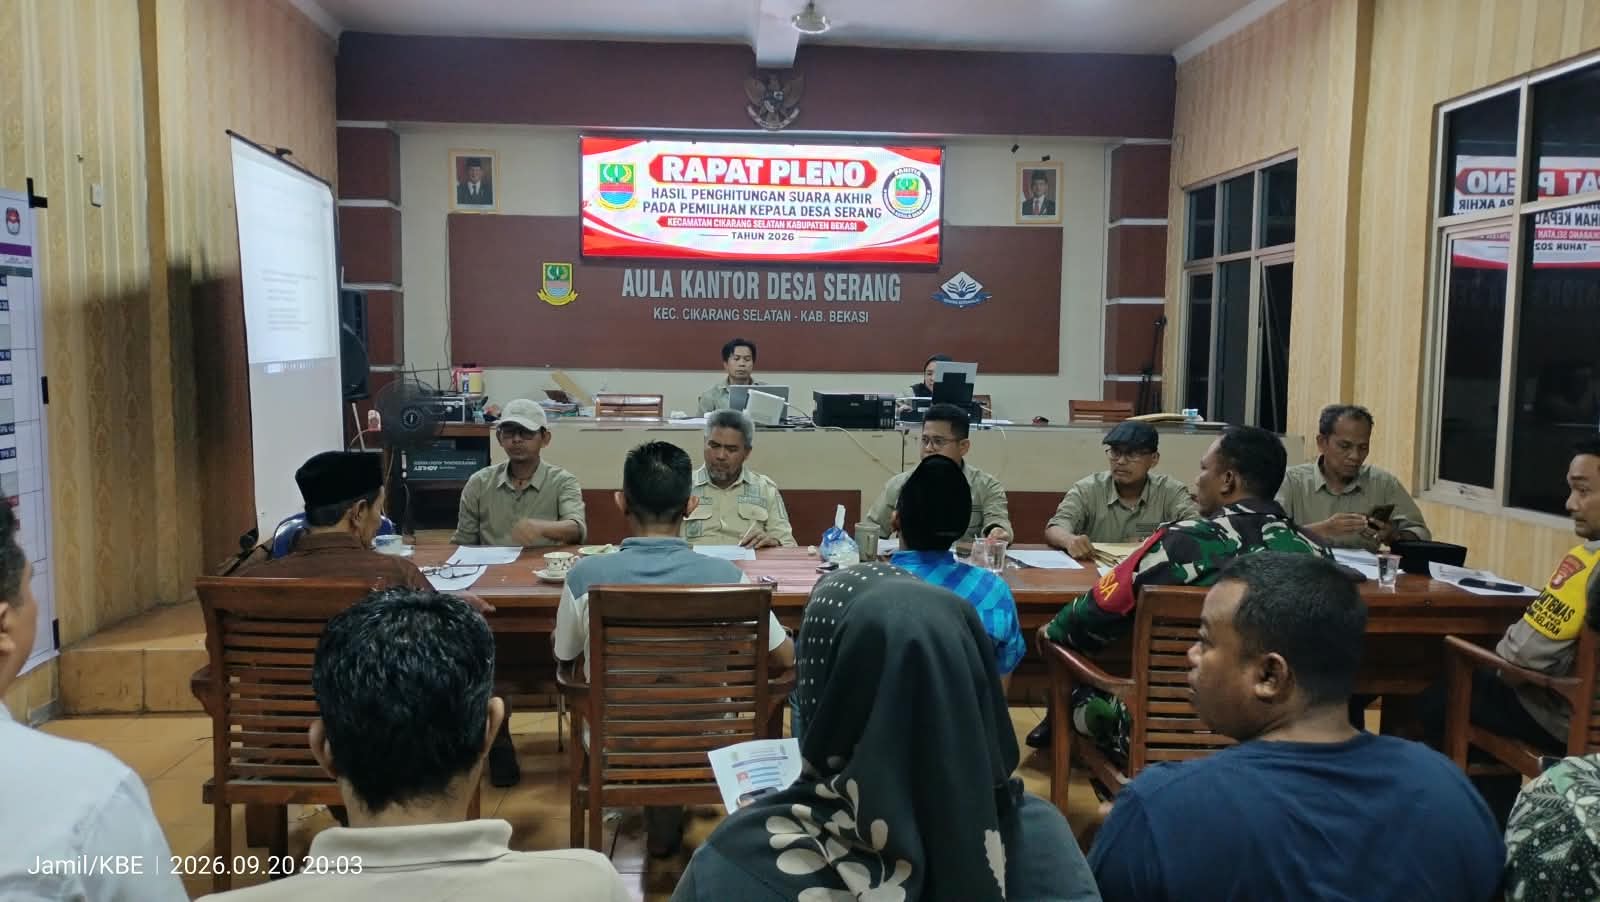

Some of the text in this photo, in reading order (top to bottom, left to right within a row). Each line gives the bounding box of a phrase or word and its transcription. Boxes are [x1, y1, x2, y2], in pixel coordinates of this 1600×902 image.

[662, 156, 866, 187] RAPAT PLENO
[651, 187, 688, 200] HASIL
[691, 189, 786, 202] PENGHITUNGAN
[789, 191, 831, 204] SUARA
[835, 192, 872, 205] AKHIR
[643, 201, 882, 219] PADA PEMILIHAN KEPALA DESA SERANG
[667, 217, 857, 231] KECAMATAN CIKARANG SELATAN KABUPATEN BEKASI
[732, 231, 795, 241] TAHUN 2026
[622, 268, 901, 302] AULA KANTOR DESA SERANG
[654, 307, 679, 320] KEC.
[682, 308, 740, 321] CIKARANG
[742, 309, 791, 322] SELATAN
[801, 310, 826, 322] KAB.
[829, 311, 869, 323] BEKASI
